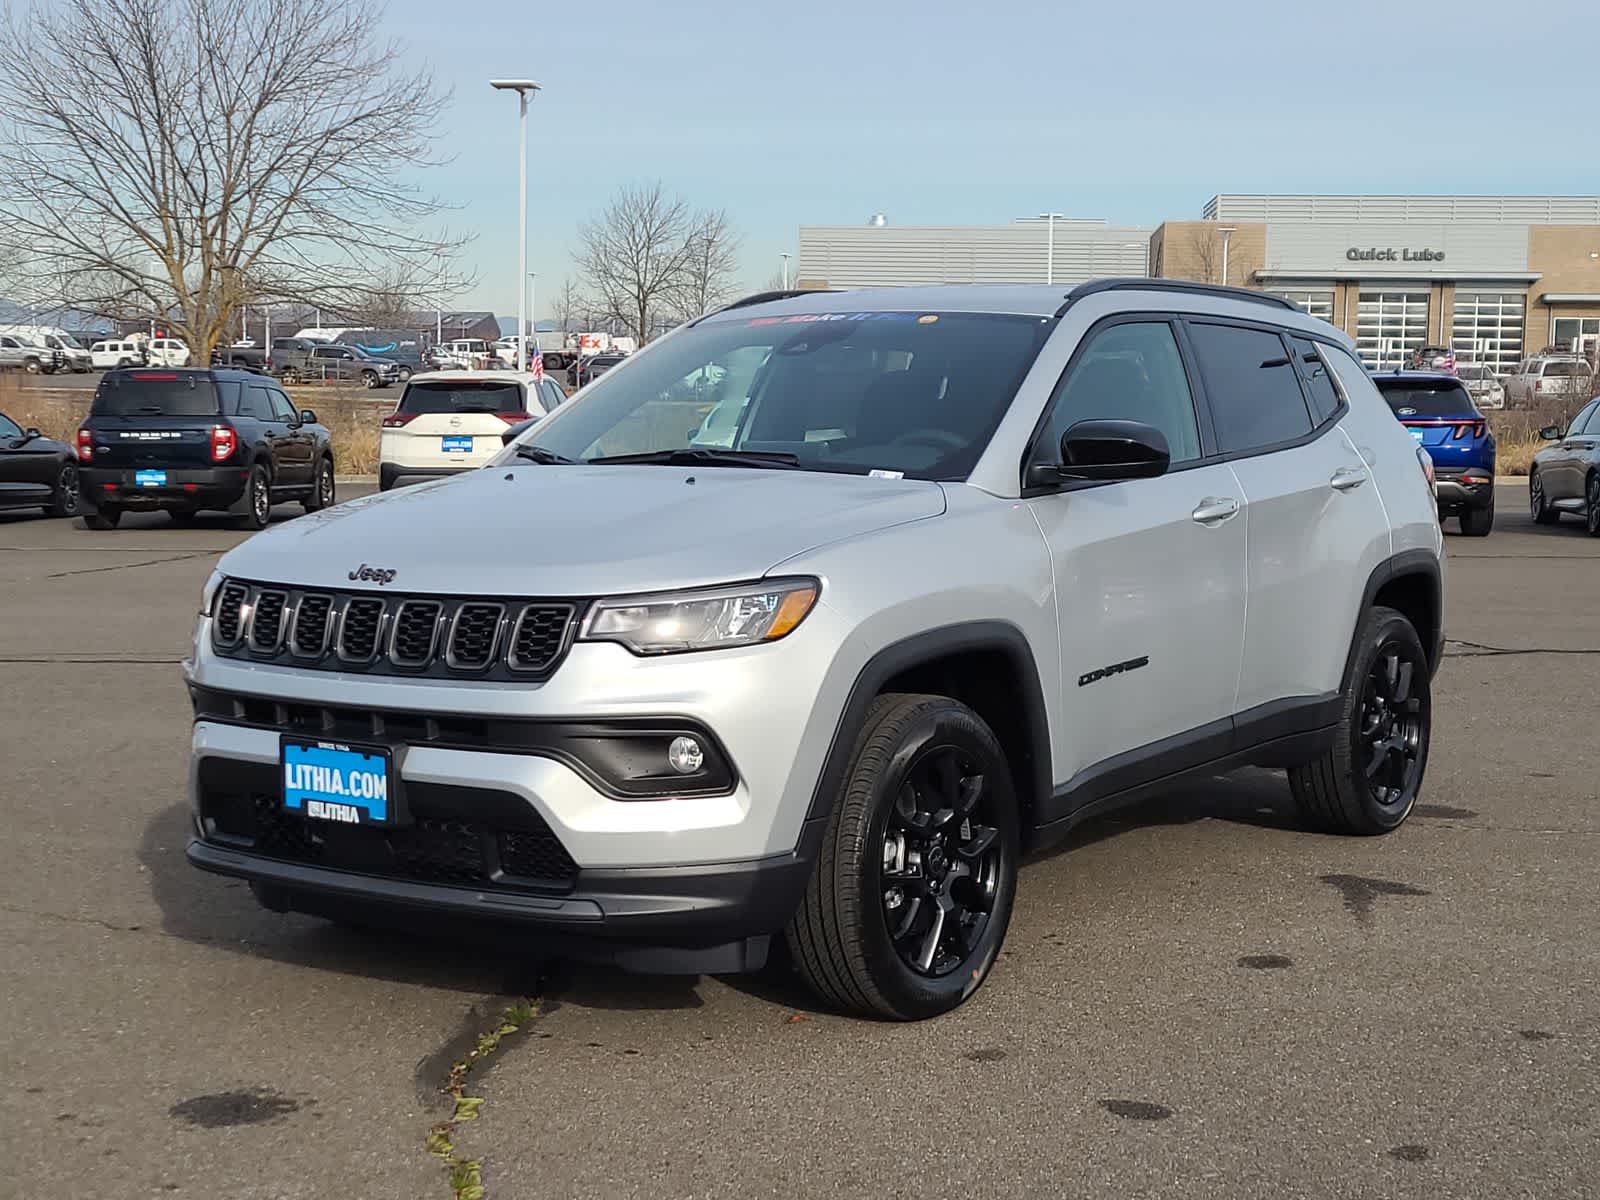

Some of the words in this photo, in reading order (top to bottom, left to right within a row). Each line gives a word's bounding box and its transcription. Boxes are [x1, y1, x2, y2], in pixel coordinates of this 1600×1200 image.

[1346, 247, 1398, 261] Quick
[1402, 248, 1446, 261] Lube
[348, 563, 397, 586] Jeep
[285, 763, 387, 801] LITHIA.COM
